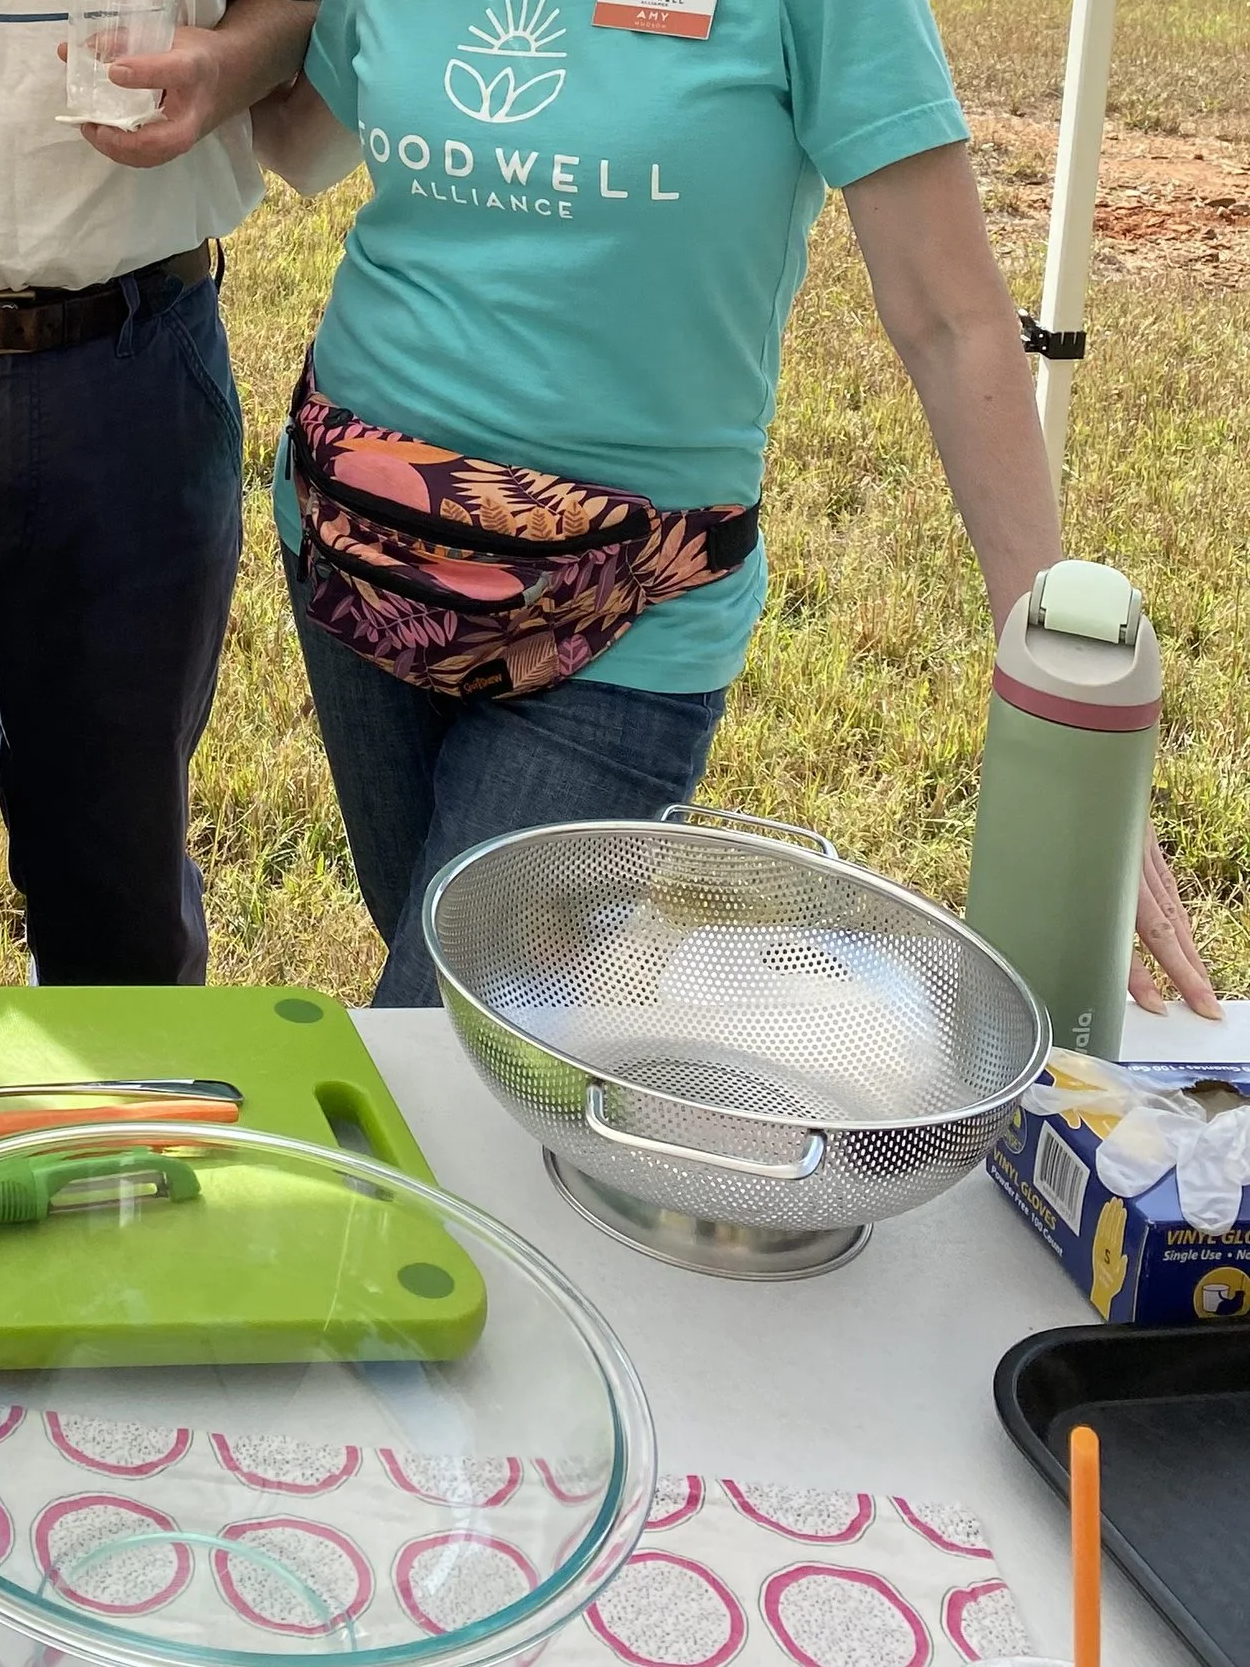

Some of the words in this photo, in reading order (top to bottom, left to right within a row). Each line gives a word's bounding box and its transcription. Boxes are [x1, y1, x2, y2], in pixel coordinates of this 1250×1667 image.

[636, 10, 670, 22] AMY
[495, 146, 682, 202] WELL
[410, 178, 574, 220] ALLIANCE
[993, 1146, 1019, 1188] VINYL
[1020, 1181, 1056, 1231] GLOVES
[990, 1165, 1015, 1198] Powder
[1014, 1192, 1030, 1217] Free
[1031, 1212, 1043, 1231] 100
[1042, 1226, 1064, 1257] Count
[1103, 1248, 1111, 1265] S
[1162, 1249, 1199, 1263] Single
[1200, 1249, 1222, 1260] Use
